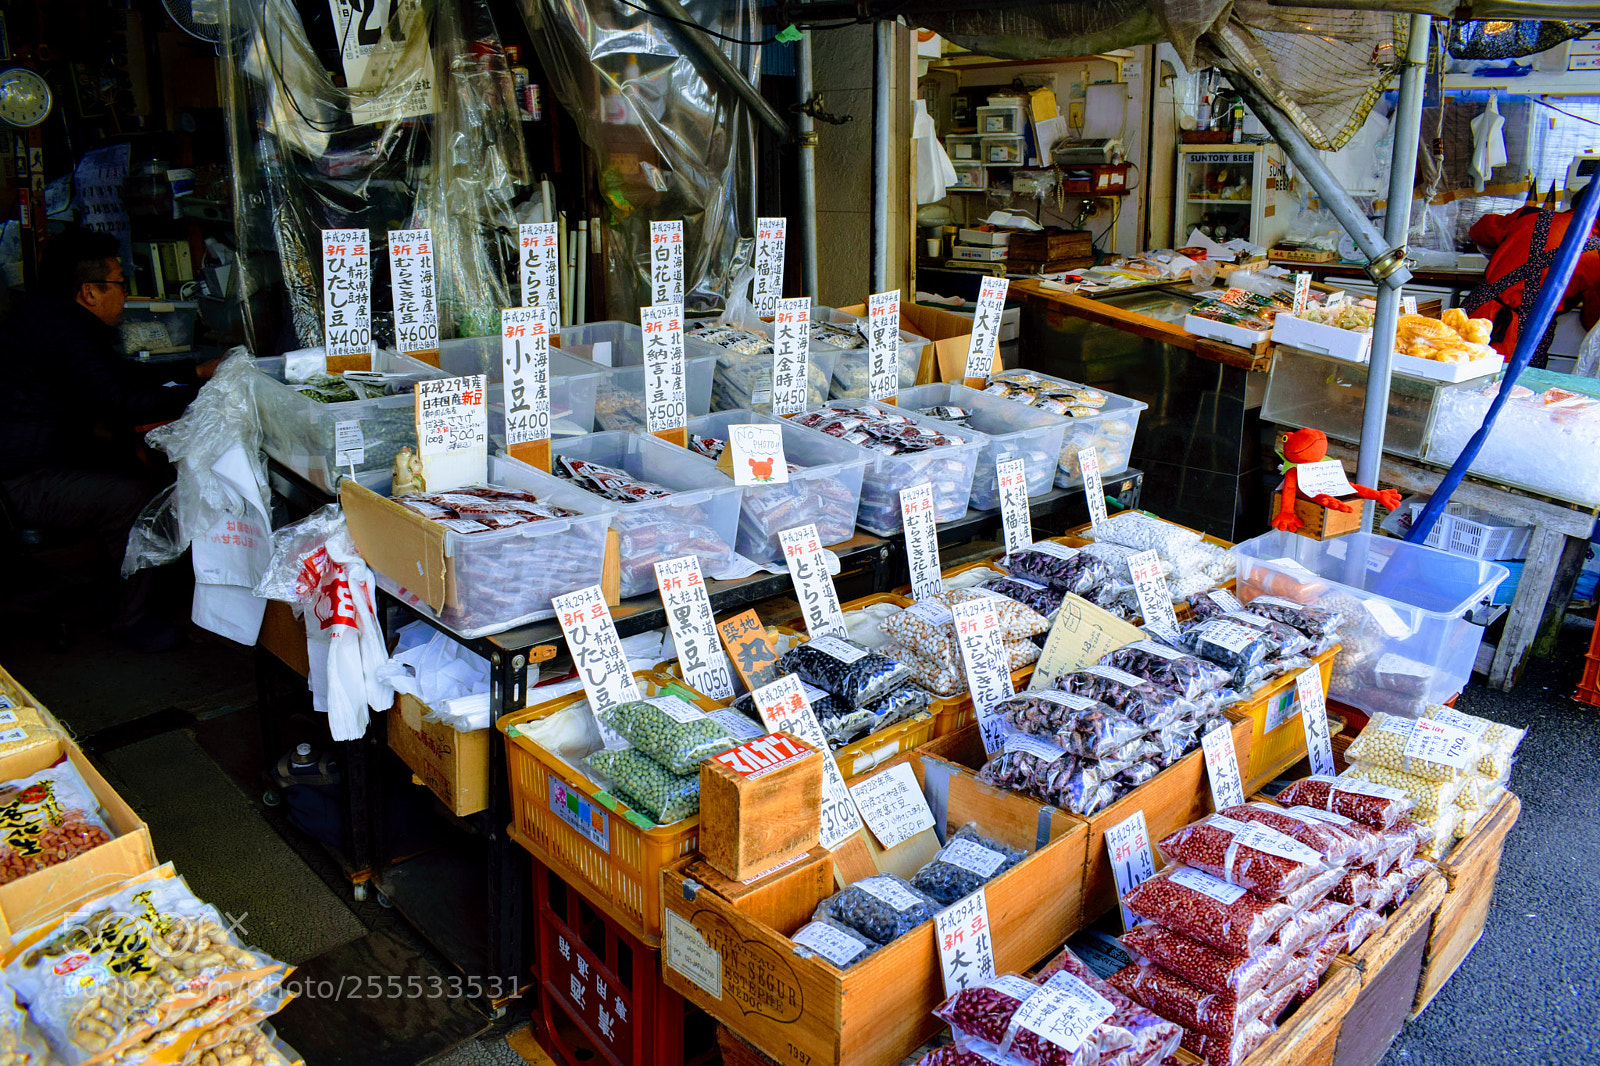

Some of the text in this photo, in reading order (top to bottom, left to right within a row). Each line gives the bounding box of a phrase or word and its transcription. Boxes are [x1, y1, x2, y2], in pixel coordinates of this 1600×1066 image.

[1191, 154, 1254, 162] SUNTORY BEER
[324, 230, 367, 243] 平成29年産
[390, 230, 430, 244] 平成29年産
[520, 224, 555, 236] 平成29年産
[652, 223, 681, 232] 平成29年産
[758, 230, 784, 239] 新豆
[522, 235, 556, 247] 新豆
[653, 233, 682, 244] 新豆
[325, 244, 368, 256] 新豆
[392, 244, 432, 256] 新豆
[545, 248, 556, 300] 北海道産
[673, 244, 682, 293] 北海道産
[757, 241, 771, 295] 大福豆
[773, 240, 784, 287] 北海道産
[419, 256, 434, 313] 北海道産
[525, 249, 542, 307] とら豆
[654, 246, 671, 304] 白花豆
[326, 258, 349, 328] ひたし豆
[355, 258, 368, 317] 山形県特産
[396, 258, 419, 325] むらさき花豆
[981, 289, 1004, 300] 新豆
[776, 300, 808, 310] 平成29年産
[871, 303, 898, 317] 新豆
[979, 299, 995, 308] 大粒
[503, 310, 546, 324] 平成29年産
[643, 309, 679, 320] 平成29年産
[777, 312, 809, 323] 新豆
[873, 317, 888, 328] 大粒
[988, 300, 1001, 348] 北海道産
[328, 328, 370, 346] ¥400
[400, 324, 438, 342] ¥600
[504, 323, 548, 338] 新豆
[644, 319, 682, 334] 新豆
[972, 309, 989, 355] 大豆
[888, 314, 898, 364] 北海道産
[776, 325, 795, 387] 大正金時
[796, 324, 808, 378] 北海道産
[872, 328, 886, 377] 黒豆
[534, 337, 548, 400] 北海道産
[647, 334, 669, 404] 大納言小豆
[670, 333, 683, 391] 北海道産
[968, 358, 992, 372] ¥350
[420, 375, 482, 397] 平成29年産
[506, 340, 531, 414] 小豆
[870, 375, 896, 393] ¥480
[423, 389, 482, 410] 日本国産 新豆
[774, 389, 805, 407] ¥450
[448, 409, 475, 426] ささげ
[507, 412, 548, 432] ¥400
[648, 404, 684, 421] ¥500
[426, 436, 443, 447] 100g
[737, 431, 754, 439] NO
[1083, 460, 1098, 471] 新豆
[1000, 473, 1024, 487] 新豆
[905, 498, 932, 515] 新豆
[1018, 485, 1030, 539] 北海道産
[1004, 489, 1020, 552] 大福豆
[787, 540, 820, 557] 新豆
[906, 515, 928, 584] むらさき花豆
[924, 511, 938, 568] 北海道産
[658, 558, 698, 577] 平成29年産
[1134, 564, 1160, 581] 新豆
[663, 573, 702, 592] 新豆
[814, 553, 838, 614] 北海道産
[913, 579, 942, 600] ¥1300
[556, 589, 602, 612] 平成29年産
[669, 593, 692, 606] 大粒
[796, 558, 829, 630] とら豆
[564, 603, 608, 626] 新豆
[694, 587, 720, 654] 北海道産
[955, 602, 994, 620] 平成29年産
[723, 615, 760, 644] 築地
[960, 615, 997, 634] 新豆
[674, 605, 706, 673] 黒豆
[599, 618, 633, 689] 山形県特産
[568, 625, 616, 712] ひたし豆
[989, 630, 1013, 699] 信州特産
[964, 636, 998, 718] むらさき花豆
[1301, 681, 1321, 702] 新豆
[1210, 742, 1234, 766] 新豆
[1308, 714, 1324, 775] 大豆
[774, 758, 793, 769] BEANS
[793, 751, 813, 762] SHOP
[1110, 822, 1142, 846] 平成29年産
[1114, 833, 1147, 862] 新豆
[769, 860, 790, 872] BEANS
[939, 894, 984, 934] 平成29年産
[943, 915, 986, 952] 新豆
[715, 929, 775, 971] CHATEAU
[570, 973, 615, 1043] 清酒
[788, 1043, 811, 1066] 1997
